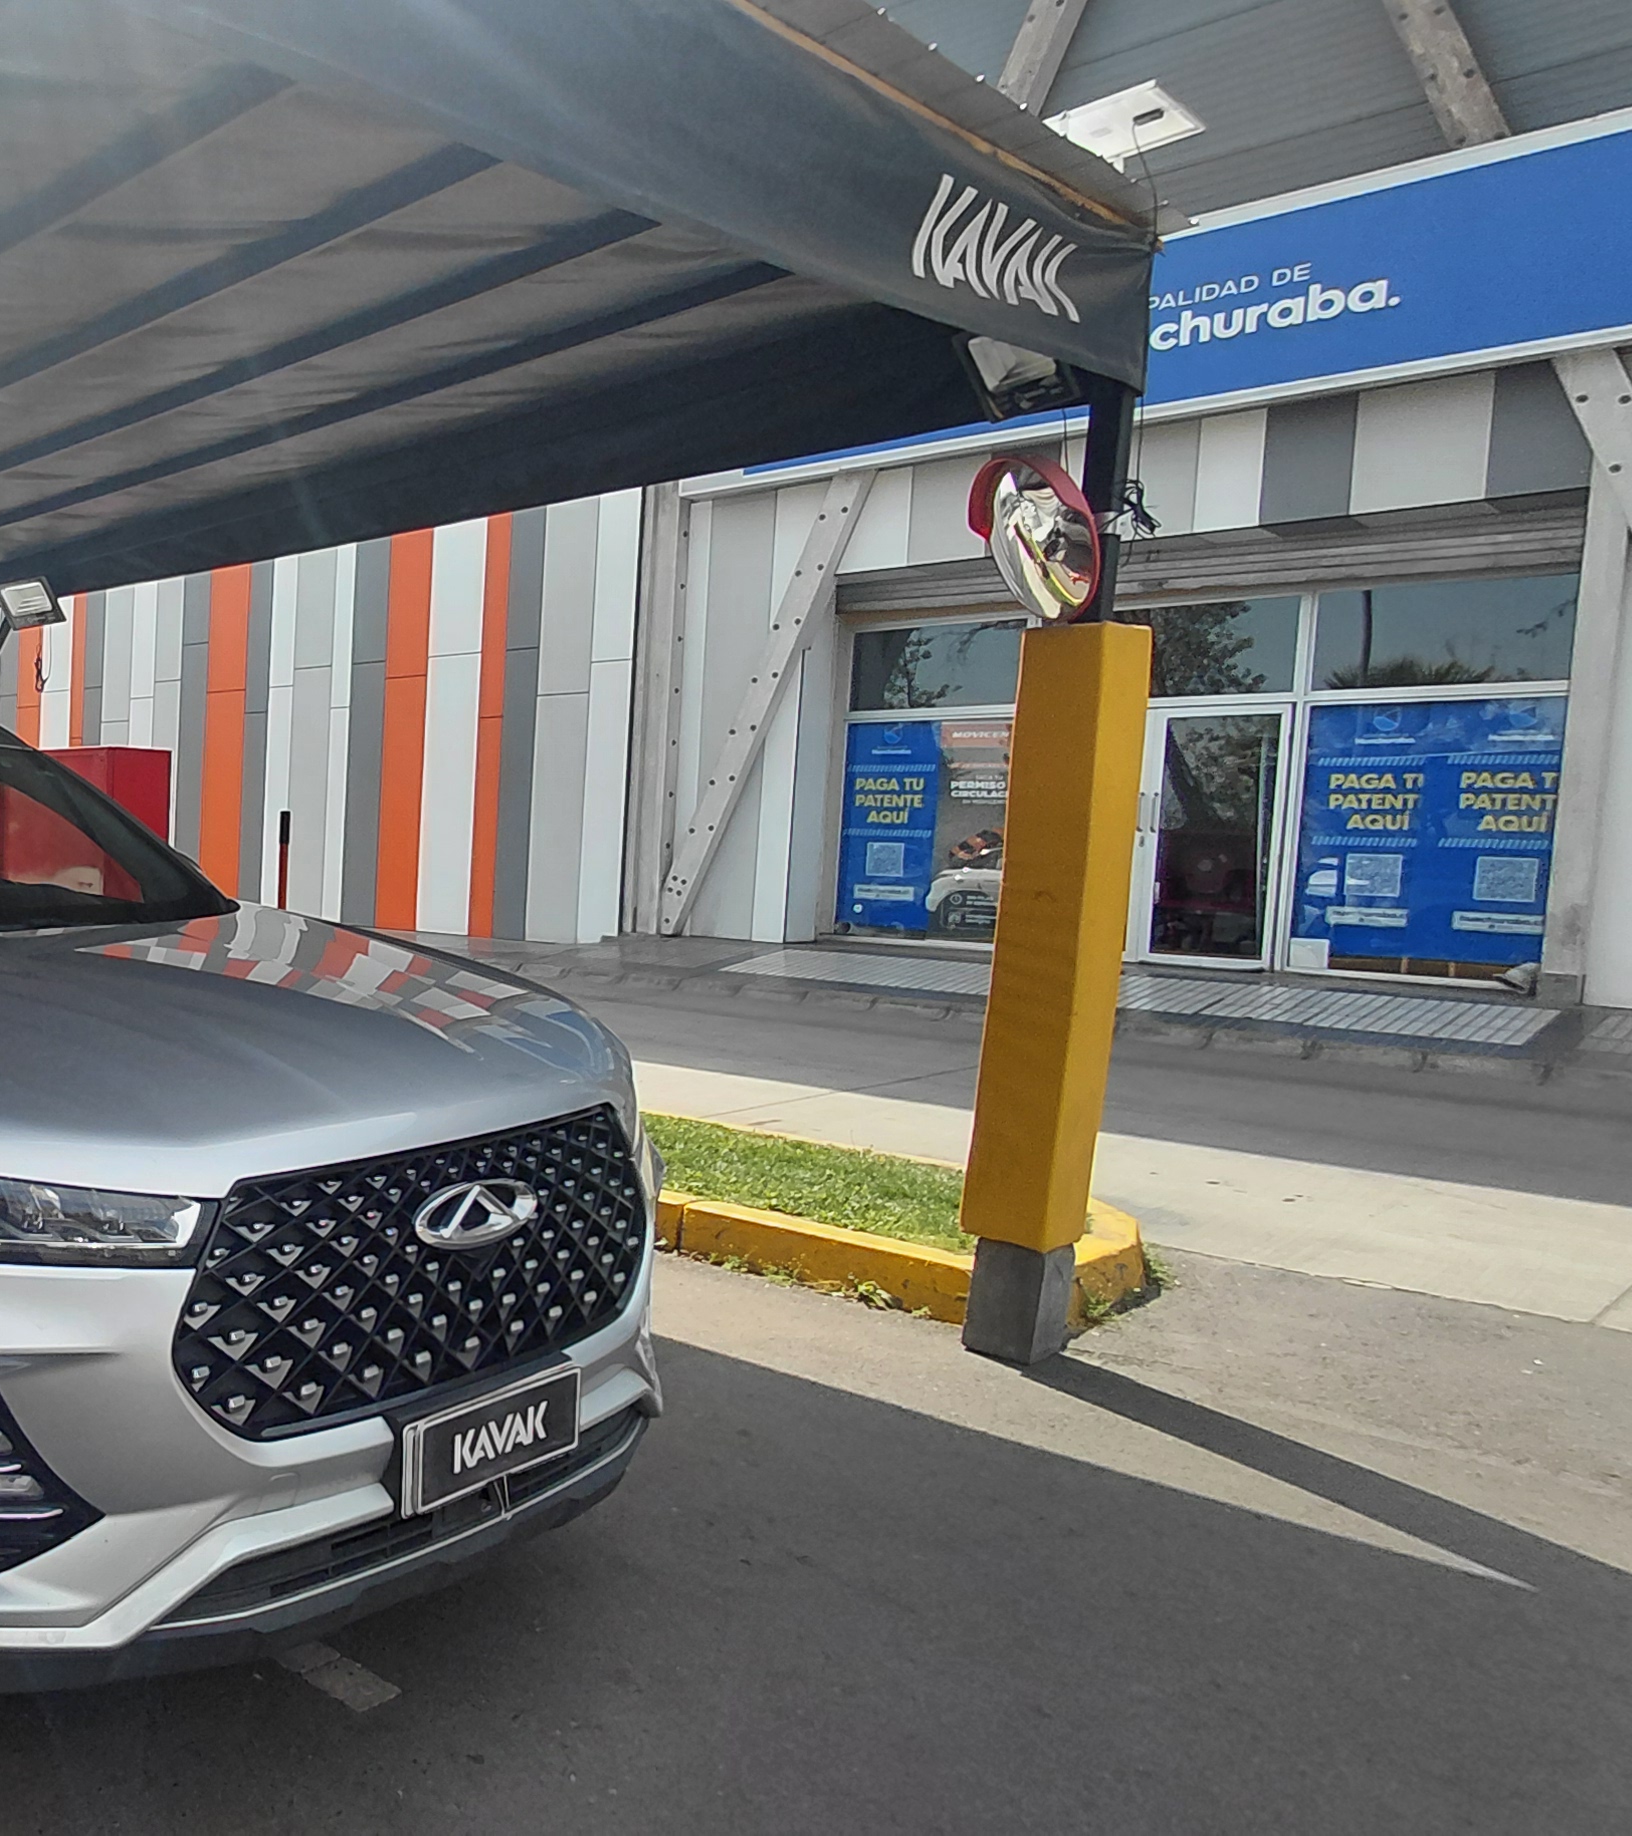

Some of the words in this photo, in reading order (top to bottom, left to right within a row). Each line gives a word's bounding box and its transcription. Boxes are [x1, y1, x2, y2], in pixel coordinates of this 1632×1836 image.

[912, 173, 1080, 323] KAVAK
[1271, 262, 1312, 287] DE
[1149, 279, 1402, 350] churaba.
[855, 778, 899, 791] PAGA
[903, 777, 924, 791] TU
[1329, 773, 1396, 789] PAGA
[1459, 771, 1537, 789] PAGA
[855, 794, 924, 807] PATENTE
[1329, 794, 1423, 809] PATENT
[866, 808, 909, 824] AQUÍ
[1346, 810, 1410, 830] AQUÍ
[1477, 811, 1549, 832] AQUÍ
[453, 1400, 548, 1474] KAVAK
